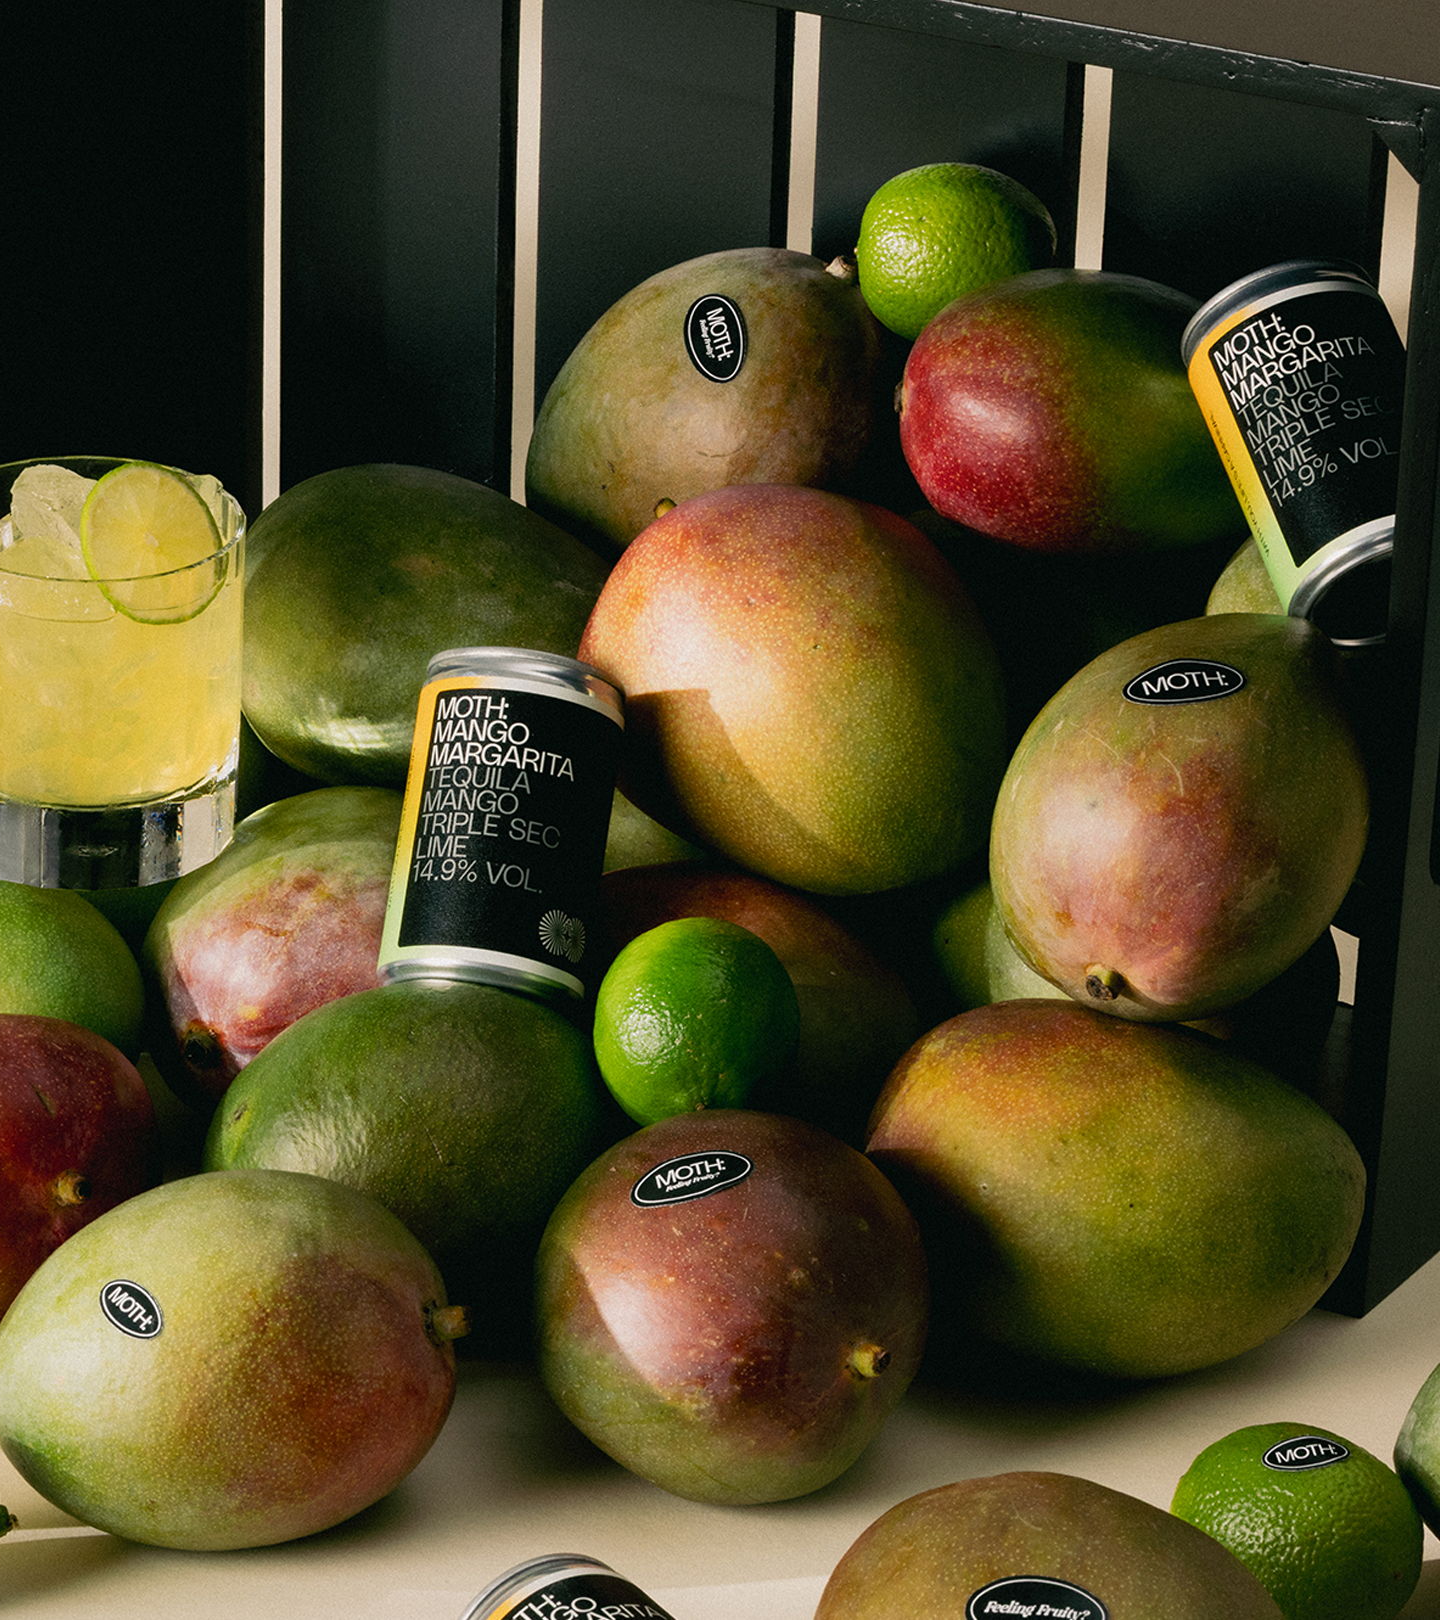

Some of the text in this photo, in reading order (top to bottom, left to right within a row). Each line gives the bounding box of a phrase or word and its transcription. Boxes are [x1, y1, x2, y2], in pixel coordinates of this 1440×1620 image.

[706, 307, 734, 361] MOTH:
[1214, 312, 1286, 371] MOTH:
[1222, 324, 1316, 391] MANGO
[1229, 336, 1375, 411] MARGARITA
[1237, 362, 1343, 427] TEQUILA
[1246, 384, 1341, 450] MANGO
[1254, 410, 1336, 466] TRIPLE
[1262, 438, 1317, 489] LIME
[1271, 454, 1338, 507] 14.9%
[1141, 671, 1229, 696] MOTH:
[437, 695, 509, 720] MOTH:
[433, 720, 530, 745] MANGO
[428, 766, 531, 794] TEQUILA
[429, 742, 575, 781] MARGARITA
[423, 790, 519, 814] MANGO
[416, 836, 470, 859] LIME
[421, 812, 561, 849] TRIPLE SEC
[413, 859, 542, 894] 14.9% VOL.
[655, 1158, 726, 1189] MOTH:
[108, 1286, 152, 1331] MOTH:
[1275, 1443, 1338, 1463] MOTH:
[984, 1600, 1091, 1620] Feeling Fruity?
